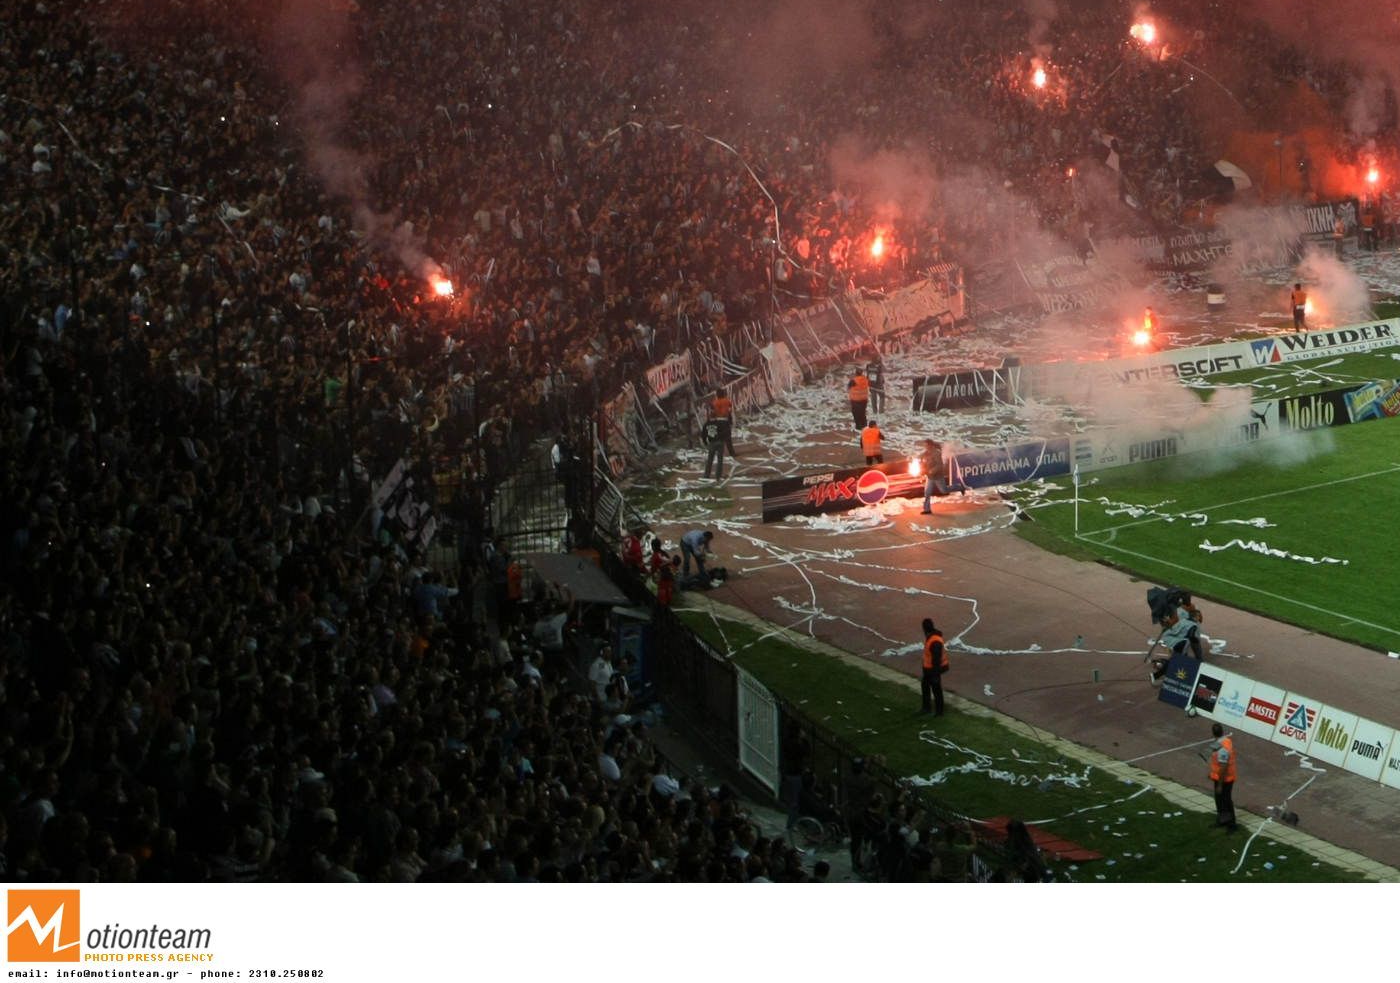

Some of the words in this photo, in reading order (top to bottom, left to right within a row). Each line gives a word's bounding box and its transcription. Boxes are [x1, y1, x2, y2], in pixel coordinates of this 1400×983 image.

[1280, 324, 1391, 351] WEIDER
[945, 383, 974, 399] ΠΑΟΚ
[1286, 397, 1335, 429] Molto
[802, 473, 835, 485] PEPSI
[956, 456, 1031, 479] ΠΡΩΤΑΘΛΗΜΑ
[806, 477, 857, 506] MAX
[1248, 702, 1277, 721] AMSTEL
[1314, 717, 1349, 751] Molto
[1351, 739, 1381, 761] PUMA
